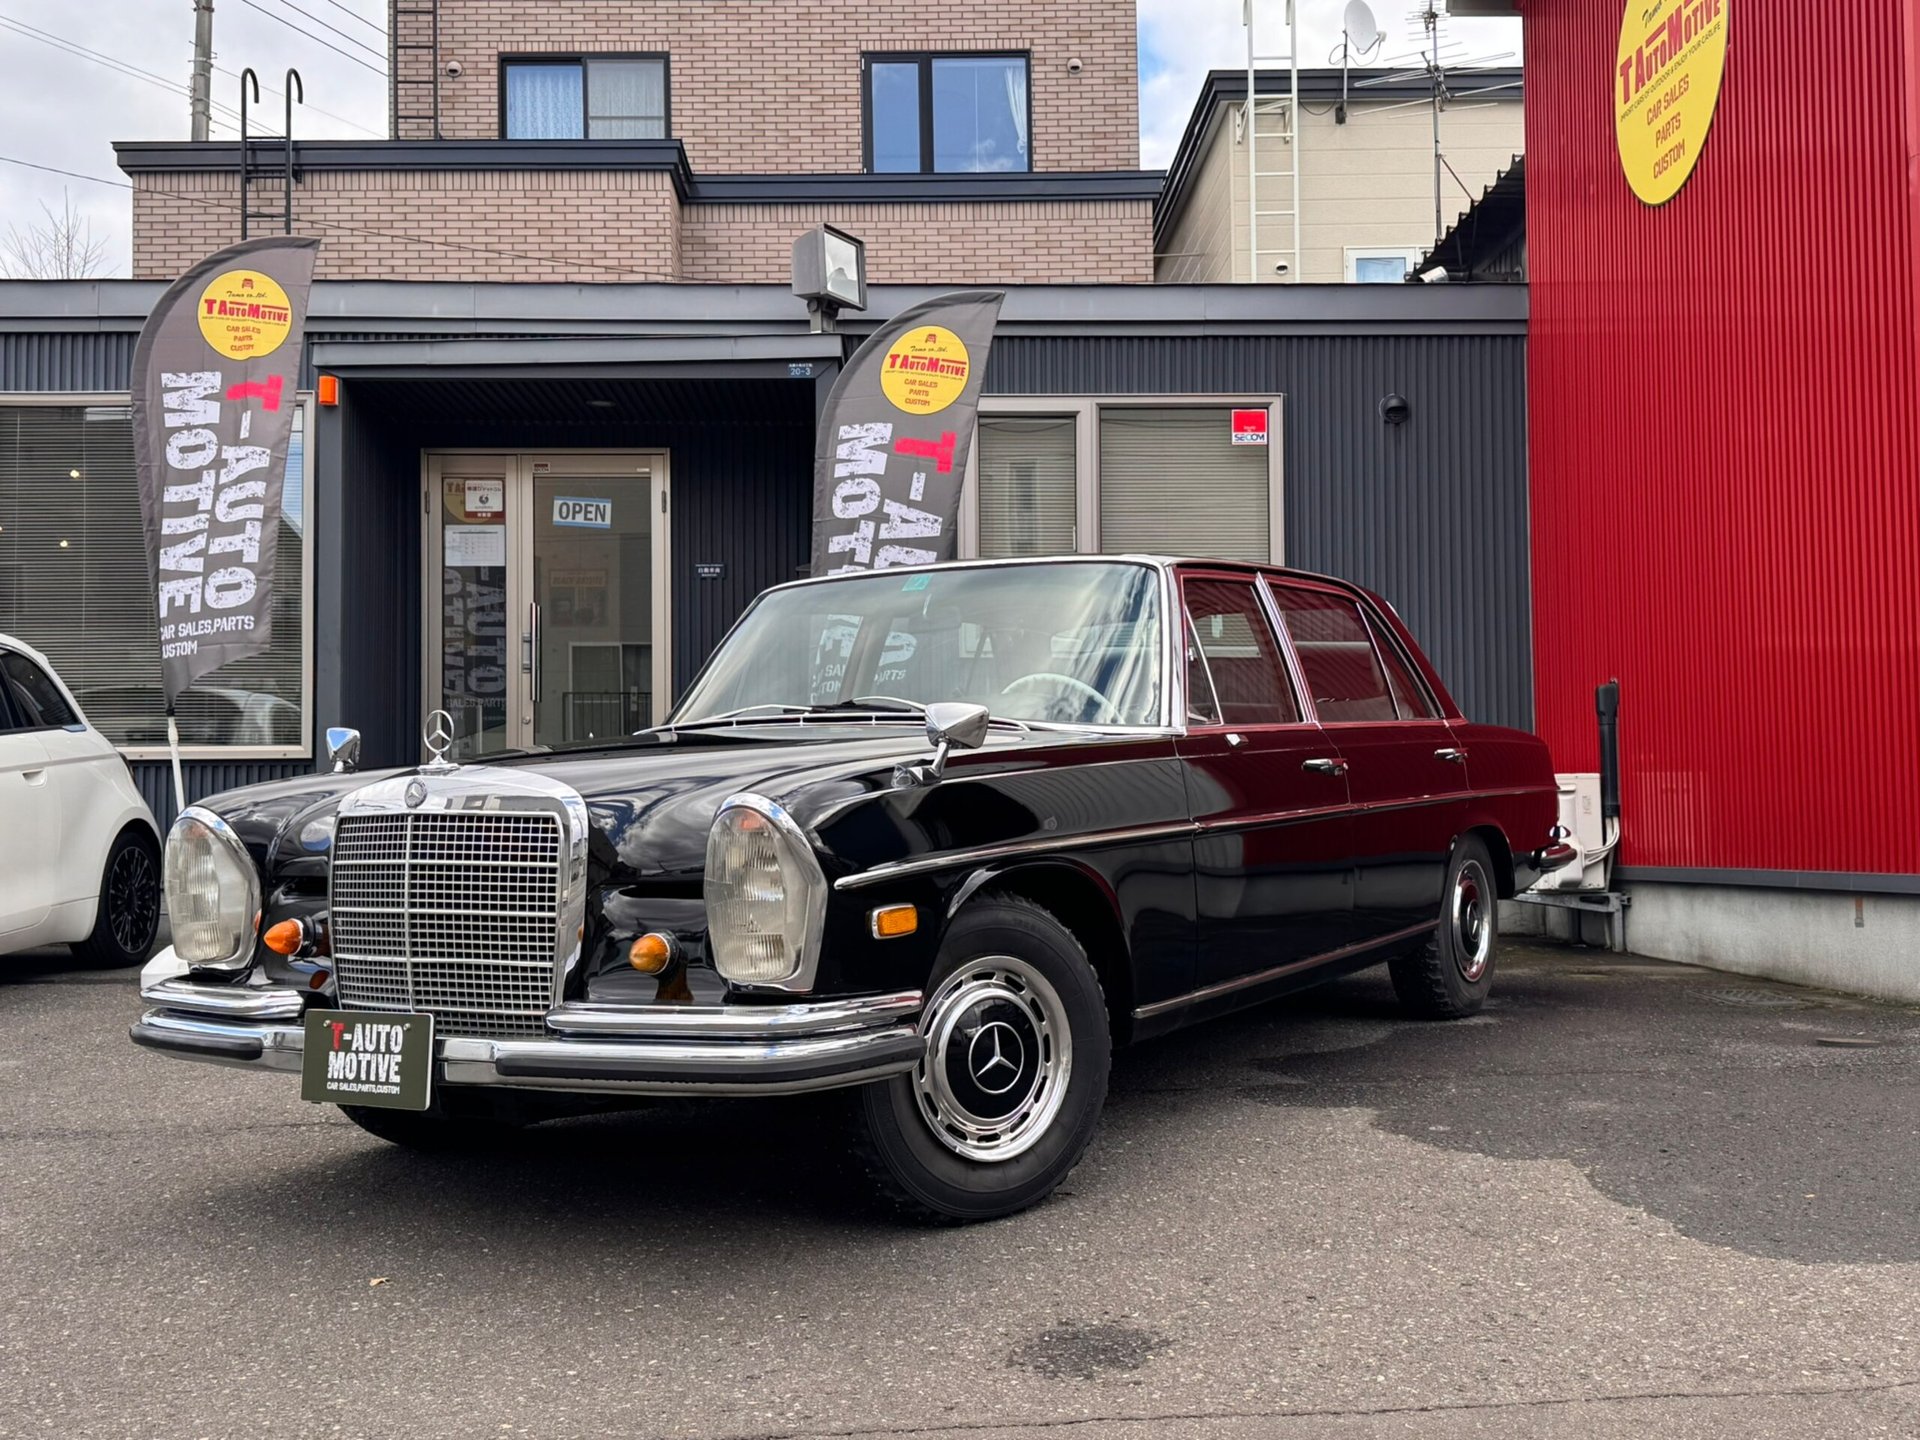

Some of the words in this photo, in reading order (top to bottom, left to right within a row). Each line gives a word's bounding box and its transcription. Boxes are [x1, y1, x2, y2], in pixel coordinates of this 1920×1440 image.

[1646, 98, 1662, 126] CAR
[1663, 73, 1689, 111] SALES
[1656, 112, 1681, 148] PARTS
[1653, 139, 1686, 179] CUSTOM
[226, 325, 240, 333] CAR
[790, 367, 811, 376] 20-3
[904, 378, 917, 386] CAR
[917, 380, 938, 388] SALES
[908, 388, 930, 397] PARTS
[904, 397, 931, 407] CUSTOM
[1234, 433, 1265, 442] SECOM
[158, 371, 222, 618] MOTIVE
[204, 374, 283, 610] T-AUTO
[558, 502, 607, 522] OPEN
[162, 639, 198, 659] USTOM
[331, 1022, 404, 1053] T-AUTO
[327, 1051, 402, 1083] MOTIVE
[326, 1081, 339, 1090] CAR
